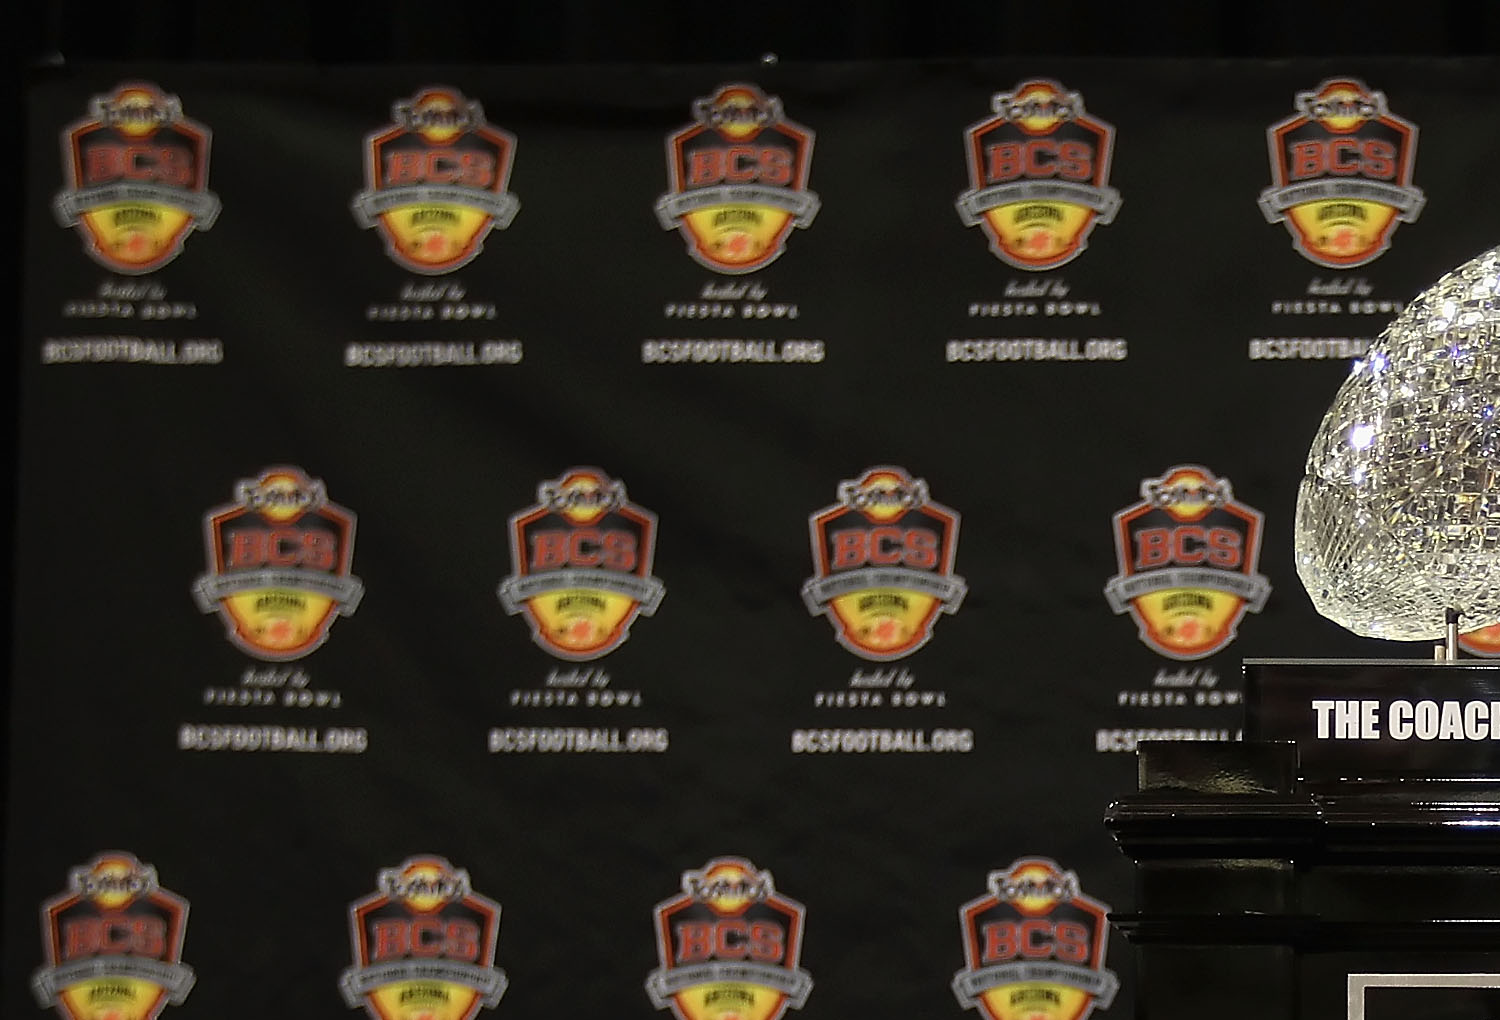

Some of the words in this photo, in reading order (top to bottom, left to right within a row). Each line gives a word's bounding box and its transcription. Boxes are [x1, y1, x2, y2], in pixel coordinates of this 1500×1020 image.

[689, 145, 792, 185] BCS
[989, 139, 1093, 181] BCS
[1292, 137, 1396, 178] BCS
[532, 529, 637, 571] BCS
[834, 526, 938, 568] BCS
[1138, 525, 1241, 567] BCS
[1312, 700, 1380, 739] THE
[374, 917, 479, 961] BCS
[679, 918, 784, 962] BCS
[985, 918, 1089, 962] BCS
